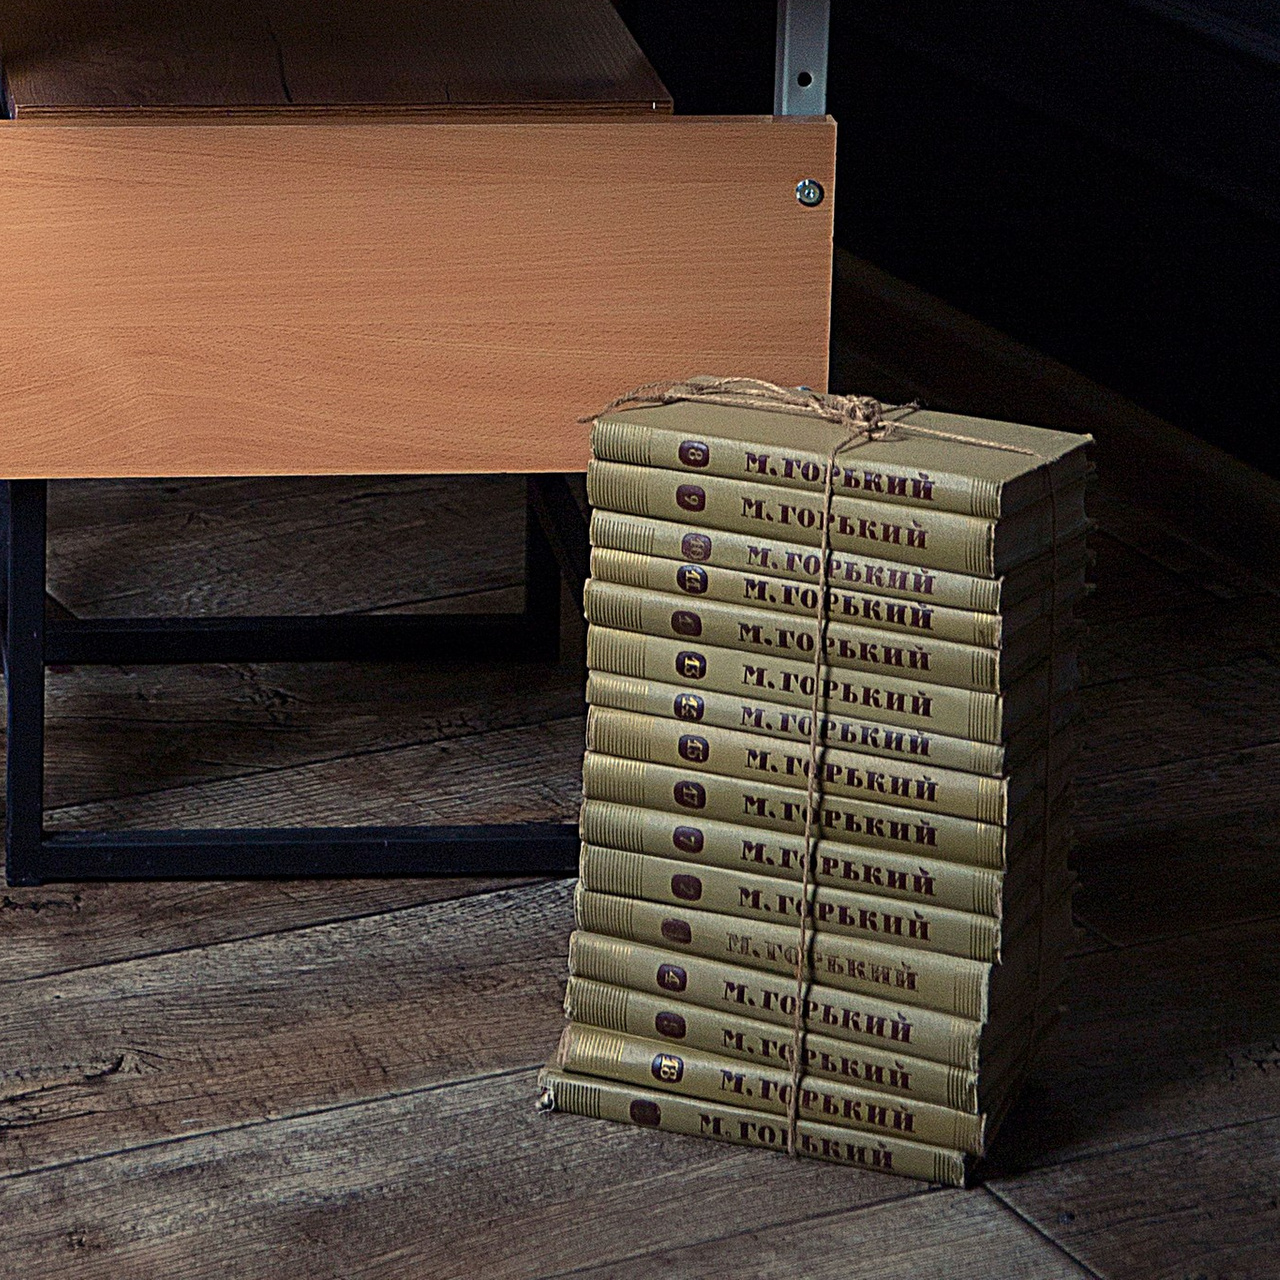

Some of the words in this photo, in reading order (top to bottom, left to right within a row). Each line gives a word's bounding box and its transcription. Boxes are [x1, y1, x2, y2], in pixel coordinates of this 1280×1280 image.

[688, 449, 703, 460] 8
[685, 495, 698, 505] 9
[686, 570, 700, 590] 11
[685, 657, 699, 677] 13
[687, 740, 703, 759] 15
[665, 971, 679, 984] 4
[661, 1056, 678, 1079] 18
